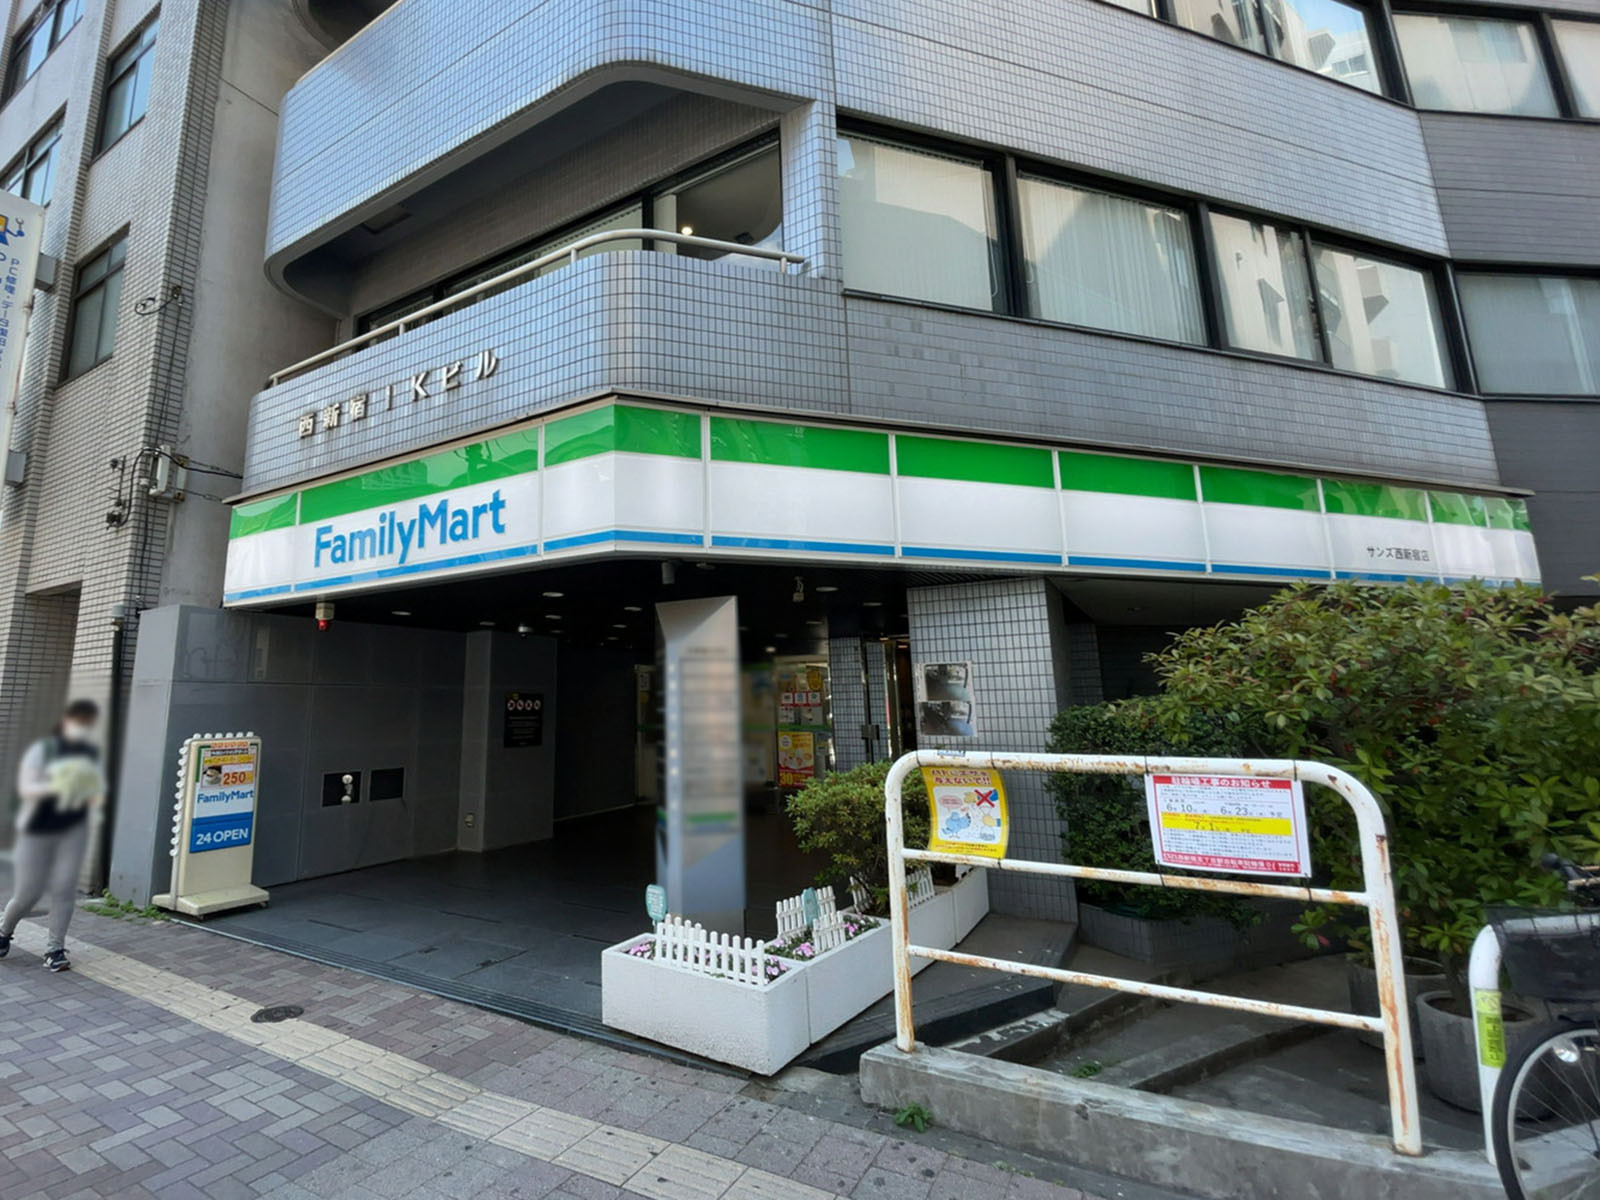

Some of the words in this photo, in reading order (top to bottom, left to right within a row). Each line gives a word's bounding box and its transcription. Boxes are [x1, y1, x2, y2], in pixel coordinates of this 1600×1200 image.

[314, 489, 506, 568] FamilyMart
[223, 771, 247, 786] 250
[197, 789, 254, 803] FamilyMart
[195, 832, 212, 845] 24
[212, 827, 249, 843] OPEN
